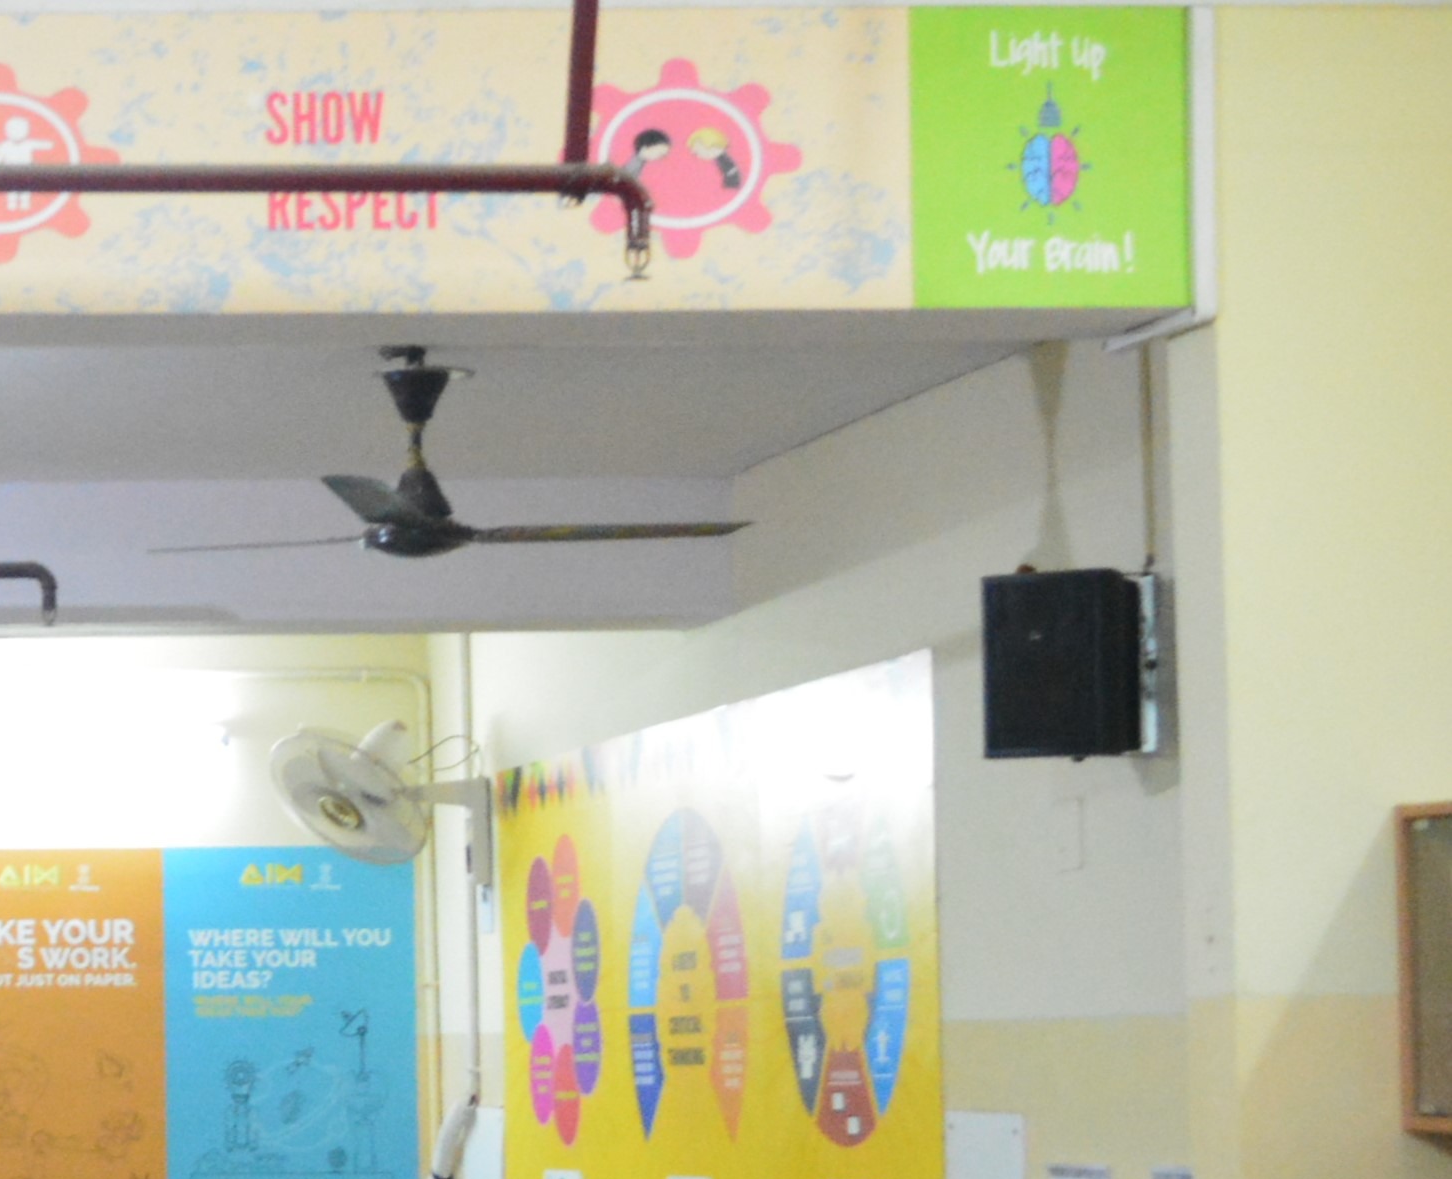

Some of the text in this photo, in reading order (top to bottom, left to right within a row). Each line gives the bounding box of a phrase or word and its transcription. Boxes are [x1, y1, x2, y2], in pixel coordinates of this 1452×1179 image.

[989, 29, 1063, 76] Light
[265, 91, 385, 146] SHOW
[265, 190, 441, 233] RESPECT
[967, 231, 1035, 276] Your
[41, 919, 135, 945] YOUR
[188, 927, 392, 948] WHERE WILL YOU
[41, 947, 137, 971] WORK.
[190, 950, 318, 969] TAKE YOUR
[16, 974, 55, 989] JUST
[57, 974, 80, 989] ON
[192, 970, 273, 989] IDEAS?
